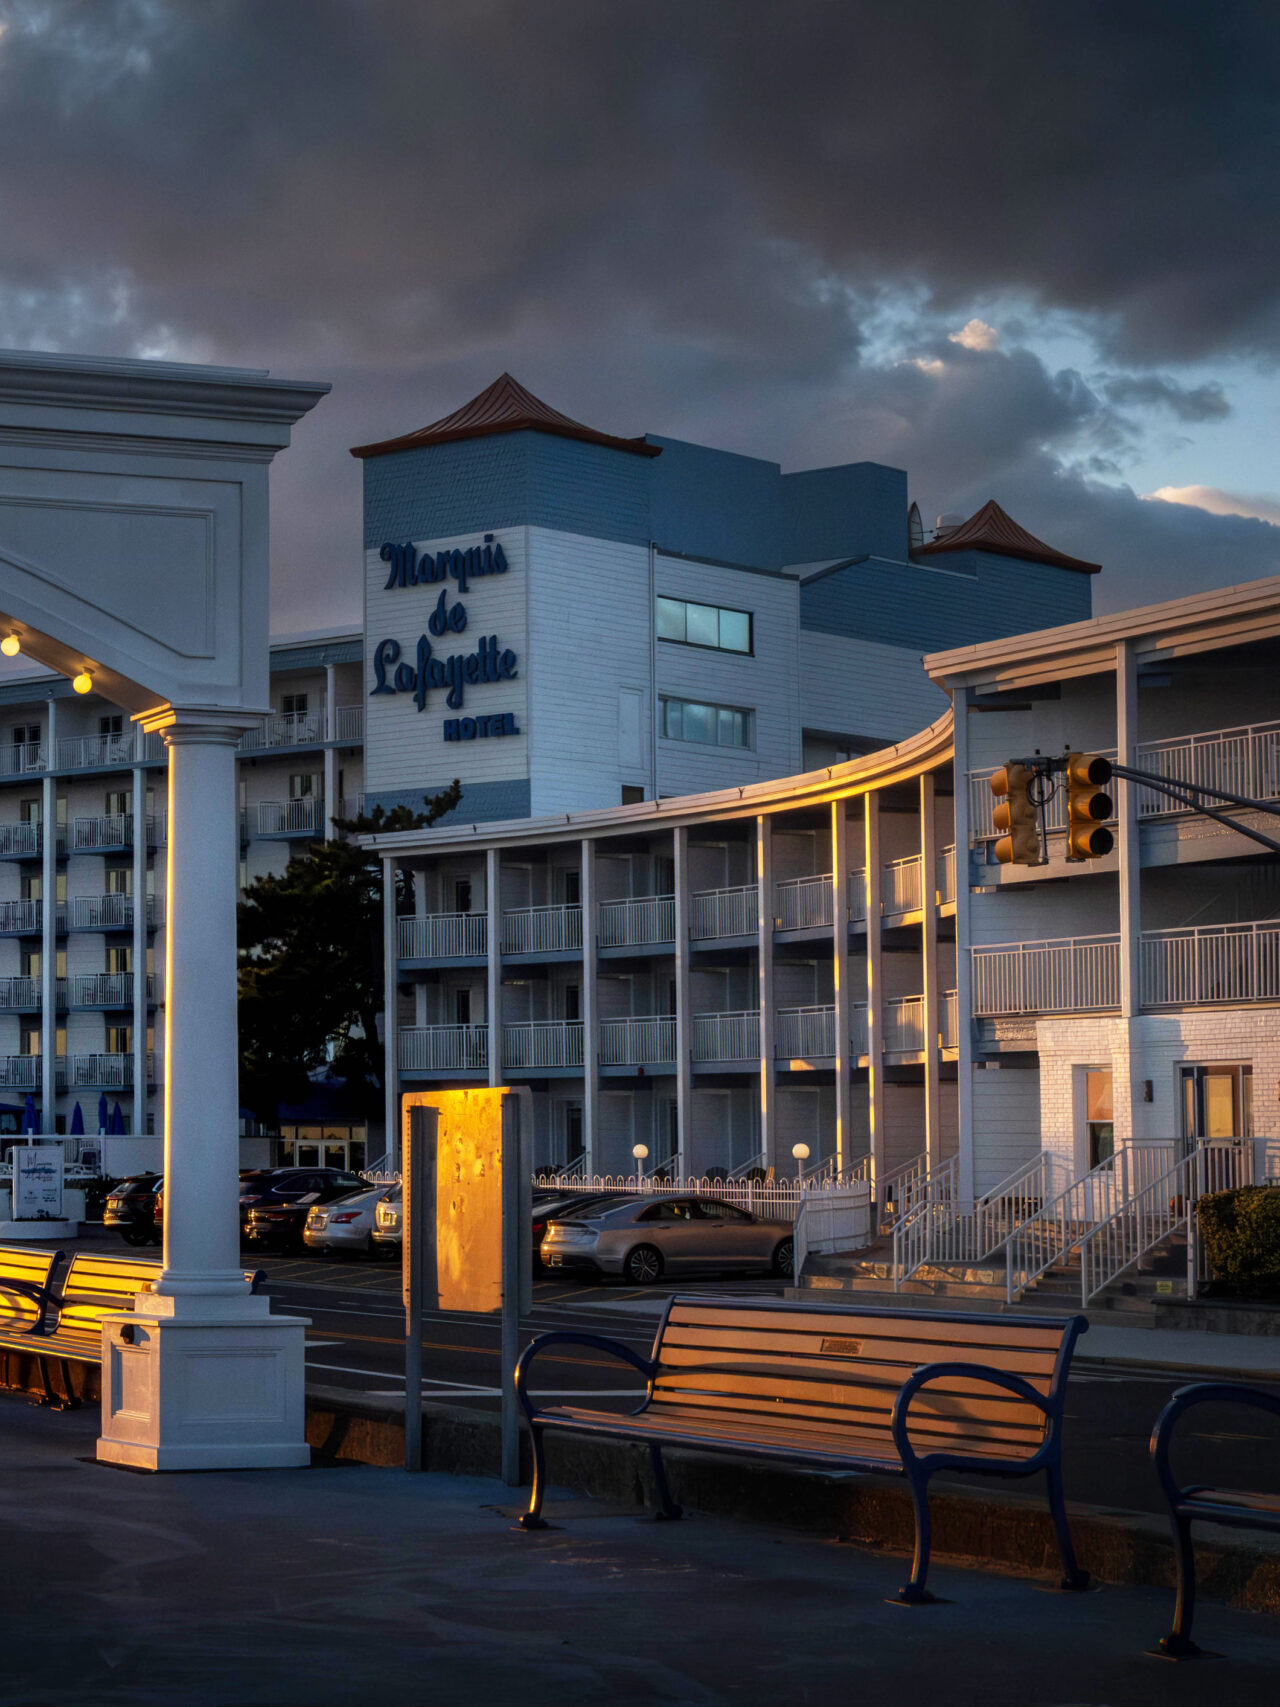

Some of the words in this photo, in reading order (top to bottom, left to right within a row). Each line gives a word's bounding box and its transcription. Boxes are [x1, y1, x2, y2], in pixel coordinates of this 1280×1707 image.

[380, 534, 508, 593] Marquis
[428, 589, 468, 637] de
[370, 634, 519, 713] Lafayette
[444, 713, 520, 742] HOTEL
